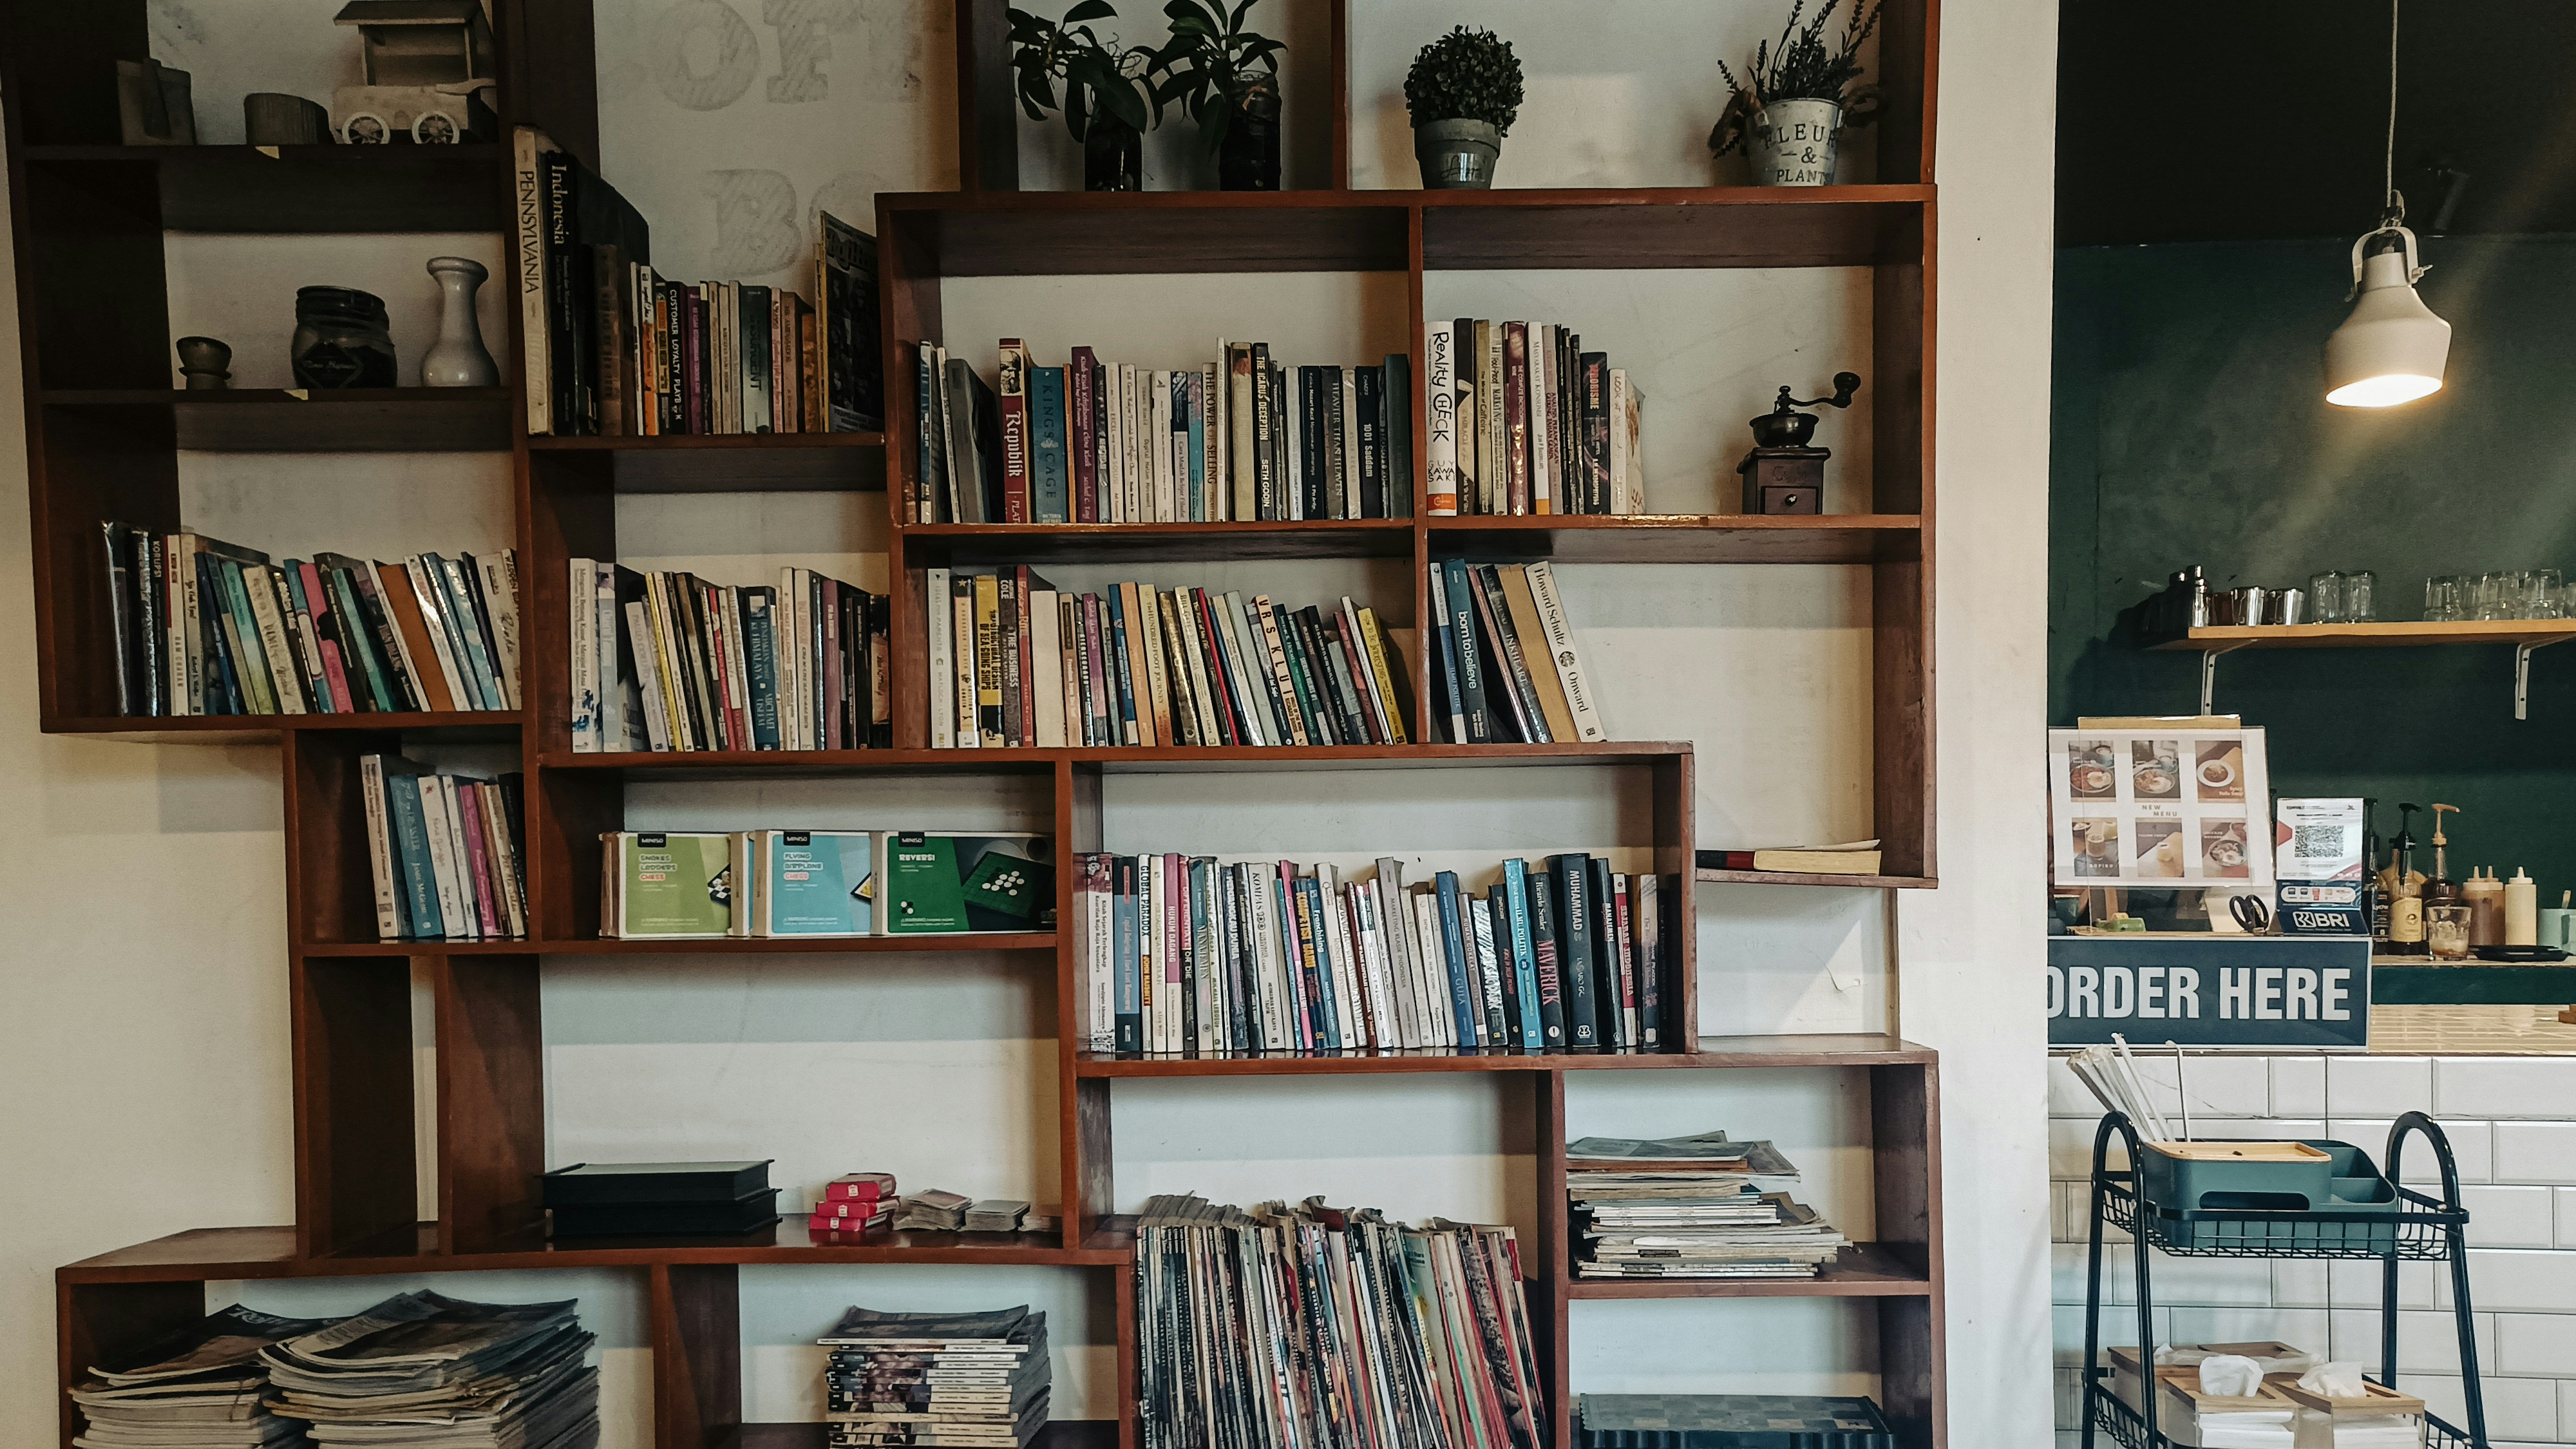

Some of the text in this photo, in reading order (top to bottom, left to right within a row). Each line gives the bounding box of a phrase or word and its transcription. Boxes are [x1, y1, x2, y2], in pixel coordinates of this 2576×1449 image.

[1801, 147, 1817, 164] &
[551, 164, 569, 244] Indonesia
[520, 171, 538, 294] PENNSYLVANIA
[670, 289, 681, 373] CUSTOMER LOYALTY
[1256, 356, 1265, 370] THE
[1257, 372, 1267, 399] ICARUS
[1206, 371, 1217, 484] THE POWER OF SELLING
[1258, 401, 1268, 440] DECEPTION
[1332, 383, 1343, 496] HEAVIER THAN HEAVEN
[1432, 393, 1452, 442] CHECK
[1004, 410, 1023, 477] Republik
[1363, 423, 1373, 477] 1001 Saddam
[1045, 453, 1056, 498] CAGE
[1428, 468, 1454, 476] KAWA
[1428, 474, 1455, 482] SAKI
[153, 541, 161, 577] KORUPSI
[633, 614, 650, 679] PAULO COELHO
[752, 633, 763, 679] HIMALAYA
[980, 623, 990, 690] OF SEA-GOING SHIPS
[1007, 631, 1018, 687] THE BUSINESS
[1280, 615, 1296, 663] SHERLOCK HOLMES
[1369, 643, 1386, 679] INTERESTING
[1458, 611, 1477, 689] born to believe
[1504, 633, 1527, 684] INKHEART
[1534, 568, 1588, 712] Howard Schultz Onward
[1066, 659, 1075, 681] Freedom
[1153, 672, 1164, 704] JOURNEY
[1285, 698, 1293, 717] RICHARD
[1451, 684, 1461, 708] POLITIK
[1141, 866, 1149, 897] GLOBAL
[1252, 873, 1264, 910] KOMPAS
[1569, 870, 1582, 931] MUHAMMAD
[1141, 899, 1150, 936] PARADOX
[1295, 892, 1316, 969] KOMPETISI BARU
[1463, 918, 1472, 942] RUMAH
[1515, 909, 1528, 956] ILMU POLITIK
[1604, 903, 1614, 942] MANAJEMEN
[2316, 913, 2350, 927] BRI
[1231, 933, 1240, 960] DUNIA
[1314, 909, 1332, 999] Franchising MARTIN
[1393, 934, 1401, 953] KLASIK
[1397, 955, 1407, 989] INDONESIA
[1466, 943, 1475, 972] COKELAT
[1535, 882, 1558, 1006] Ricardo Semler MAVERICK
[1620, 905, 1633, 996] SEJARAH INDONESIA
[1143, 975, 1151, 1005] NAISBITT
[1333, 938, 1348, 1001] Robert Kiyosaki
[1455, 978, 1466, 1005] GULA
[1363, 987, 1372, 1012] INDONESIA
[2047, 966, 2351, 1021] ORDER HERE
